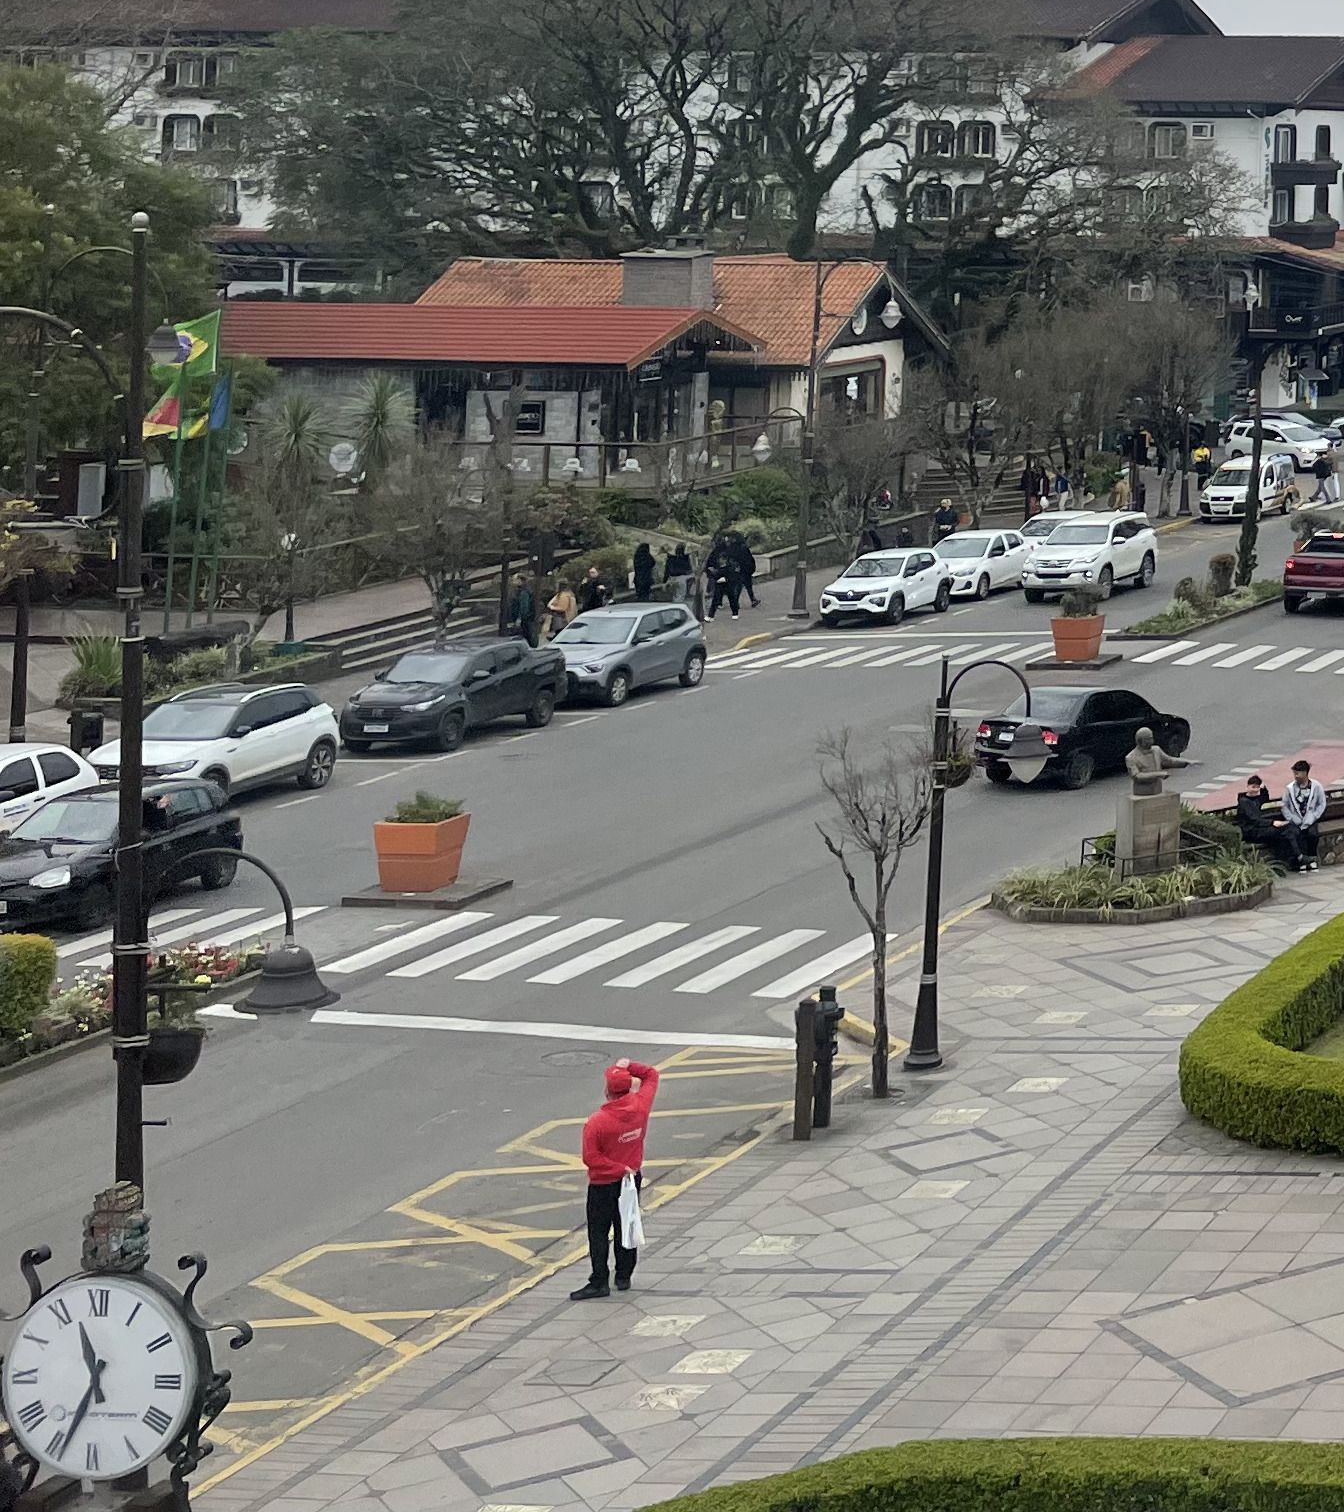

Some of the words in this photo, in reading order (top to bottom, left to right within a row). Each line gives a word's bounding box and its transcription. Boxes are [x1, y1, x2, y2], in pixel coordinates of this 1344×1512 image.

[47, 1298, 73, 1330] XI
[87, 1289, 111, 1317] XII
[146, 1331, 173, 1354] II
[154, 1373, 182, 1390] III
